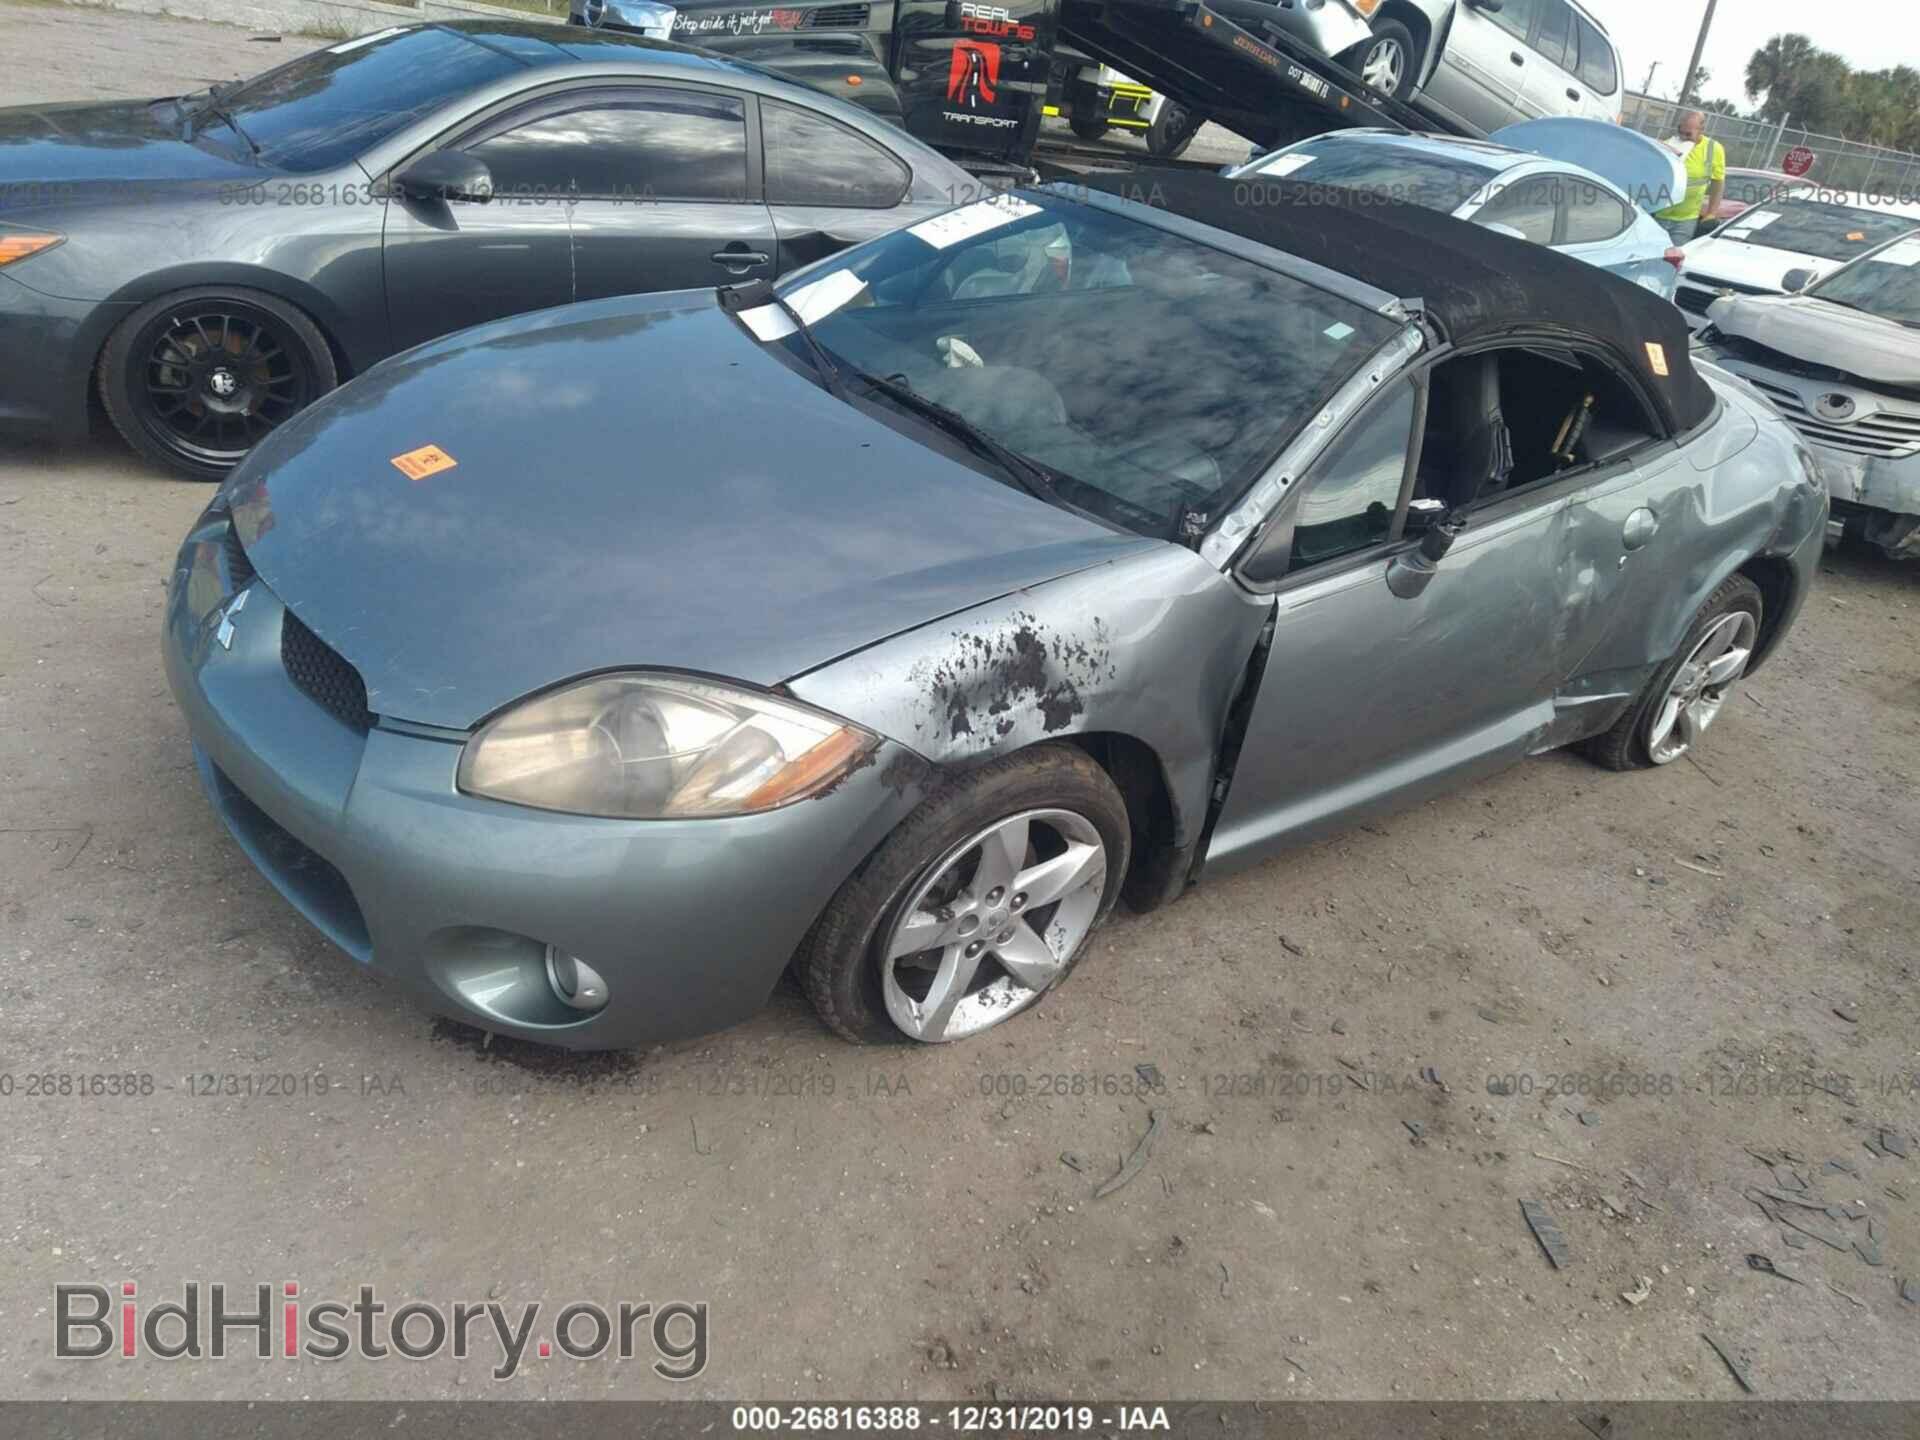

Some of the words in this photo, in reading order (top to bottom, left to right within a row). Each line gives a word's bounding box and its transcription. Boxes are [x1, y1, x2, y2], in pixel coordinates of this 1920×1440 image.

[674, 14, 698, 35] Step
[733, 10, 757, 35] just
[753, 10, 773, 34] got
[961, 3, 1019, 24] REAL
[943, 111, 1018, 129] TRANSPORT
